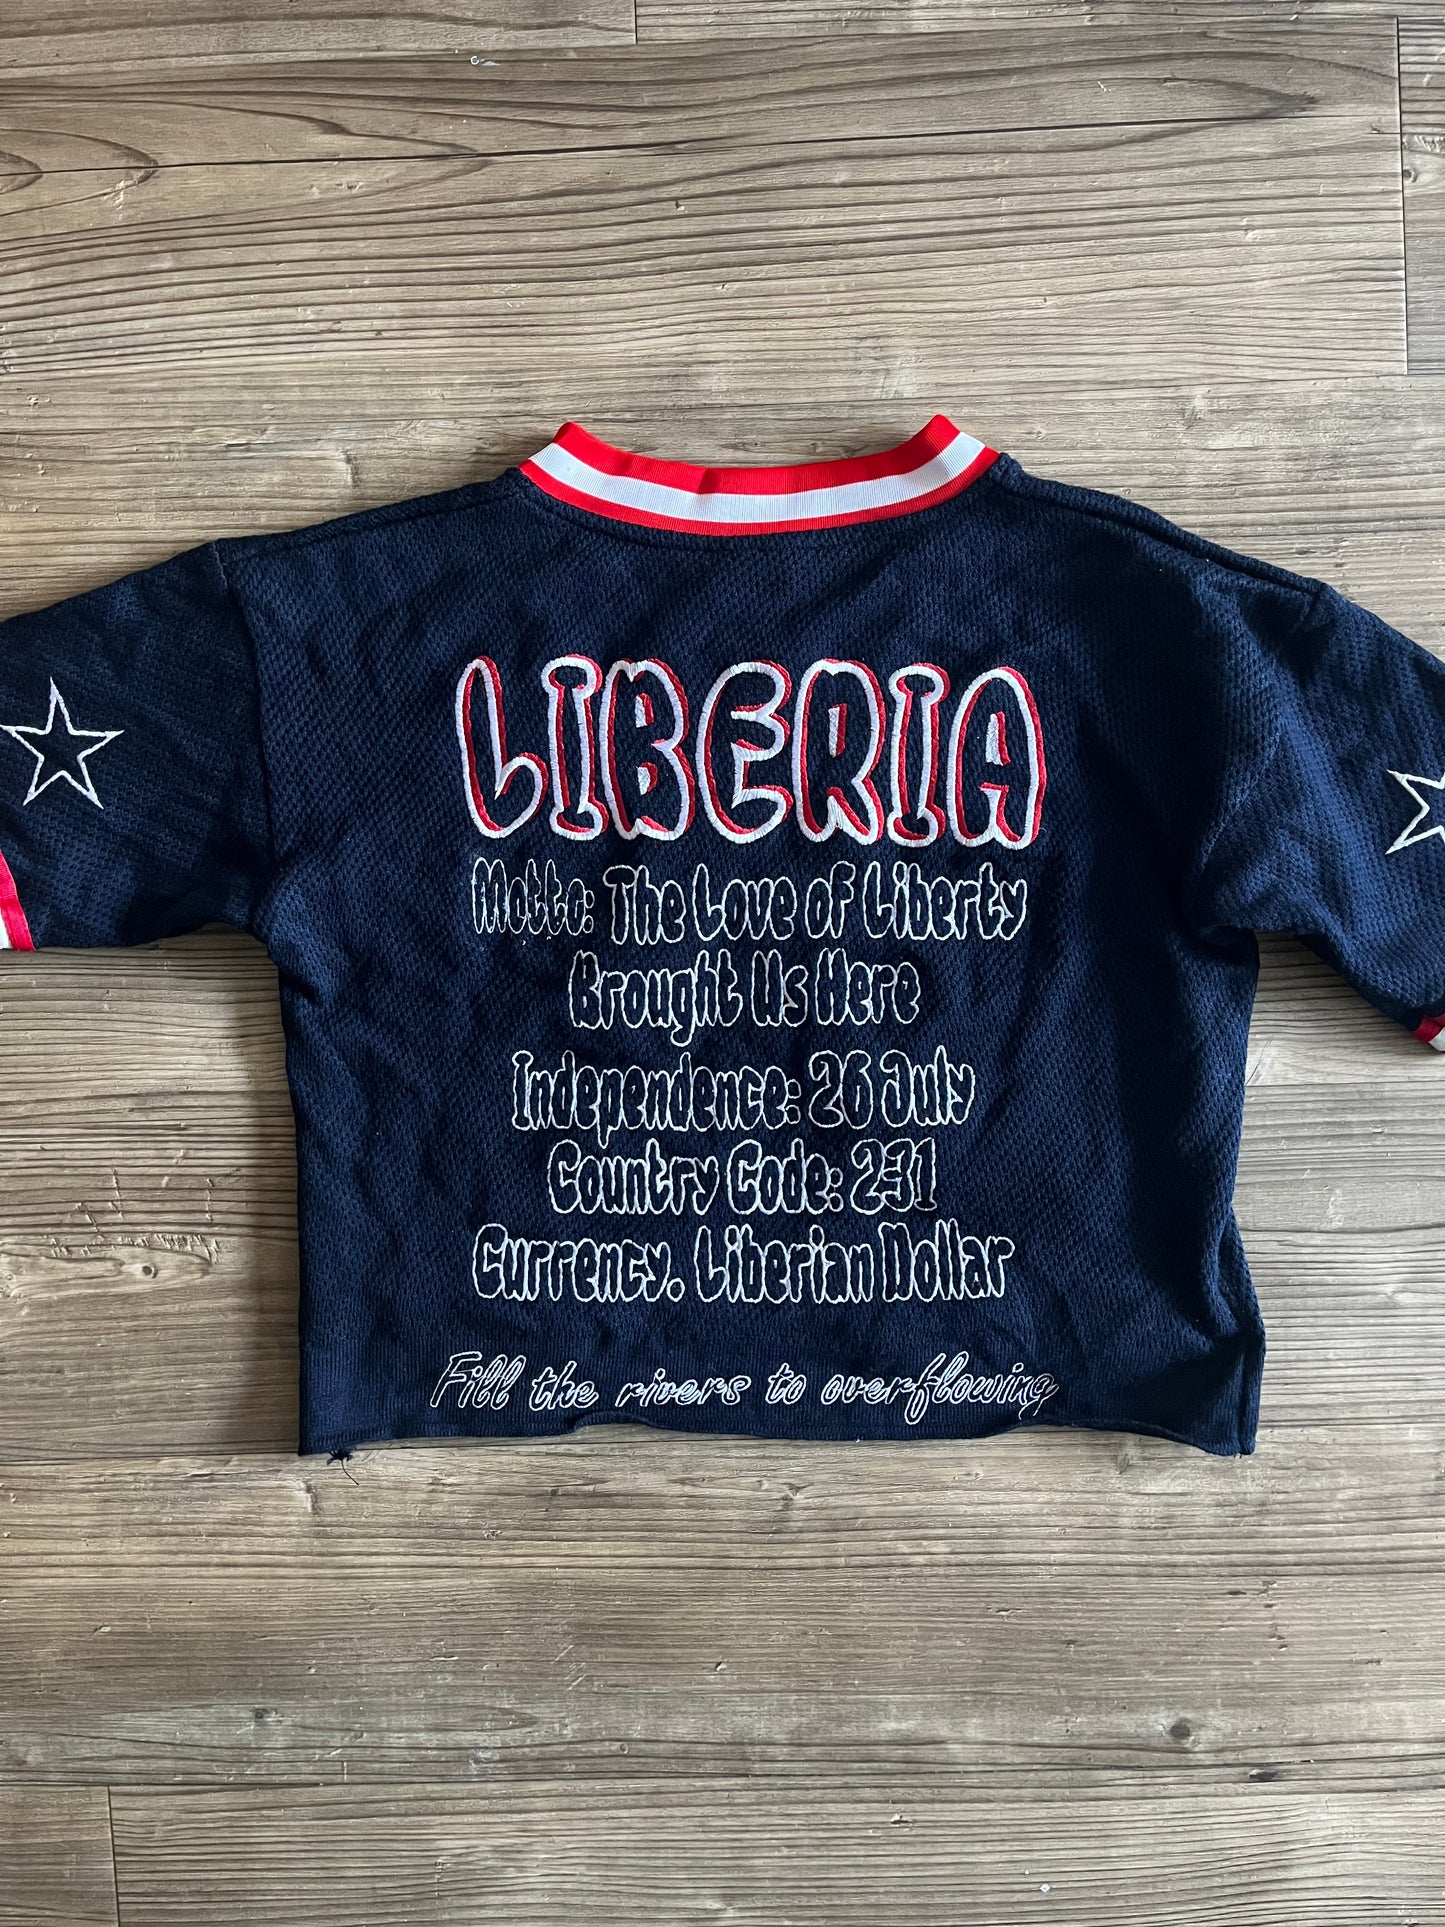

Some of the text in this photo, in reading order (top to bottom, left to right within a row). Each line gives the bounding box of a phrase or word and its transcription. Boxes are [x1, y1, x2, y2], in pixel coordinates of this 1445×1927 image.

[455, 654, 1048, 850] LIBERIA
[471, 857, 1028, 945] Motto: The Love of Liberty
[568, 947, 921, 1047] Brought Us Here
[511, 1045, 976, 1149] Independence: 26 July
[547, 1137, 937, 1215] Country Code: 231
[693, 1224, 875, 1303] Liberian
[878, 1219, 1015, 1302] Dollar
[431, 1351, 1060, 1426] Fill the rivers to overflowing
